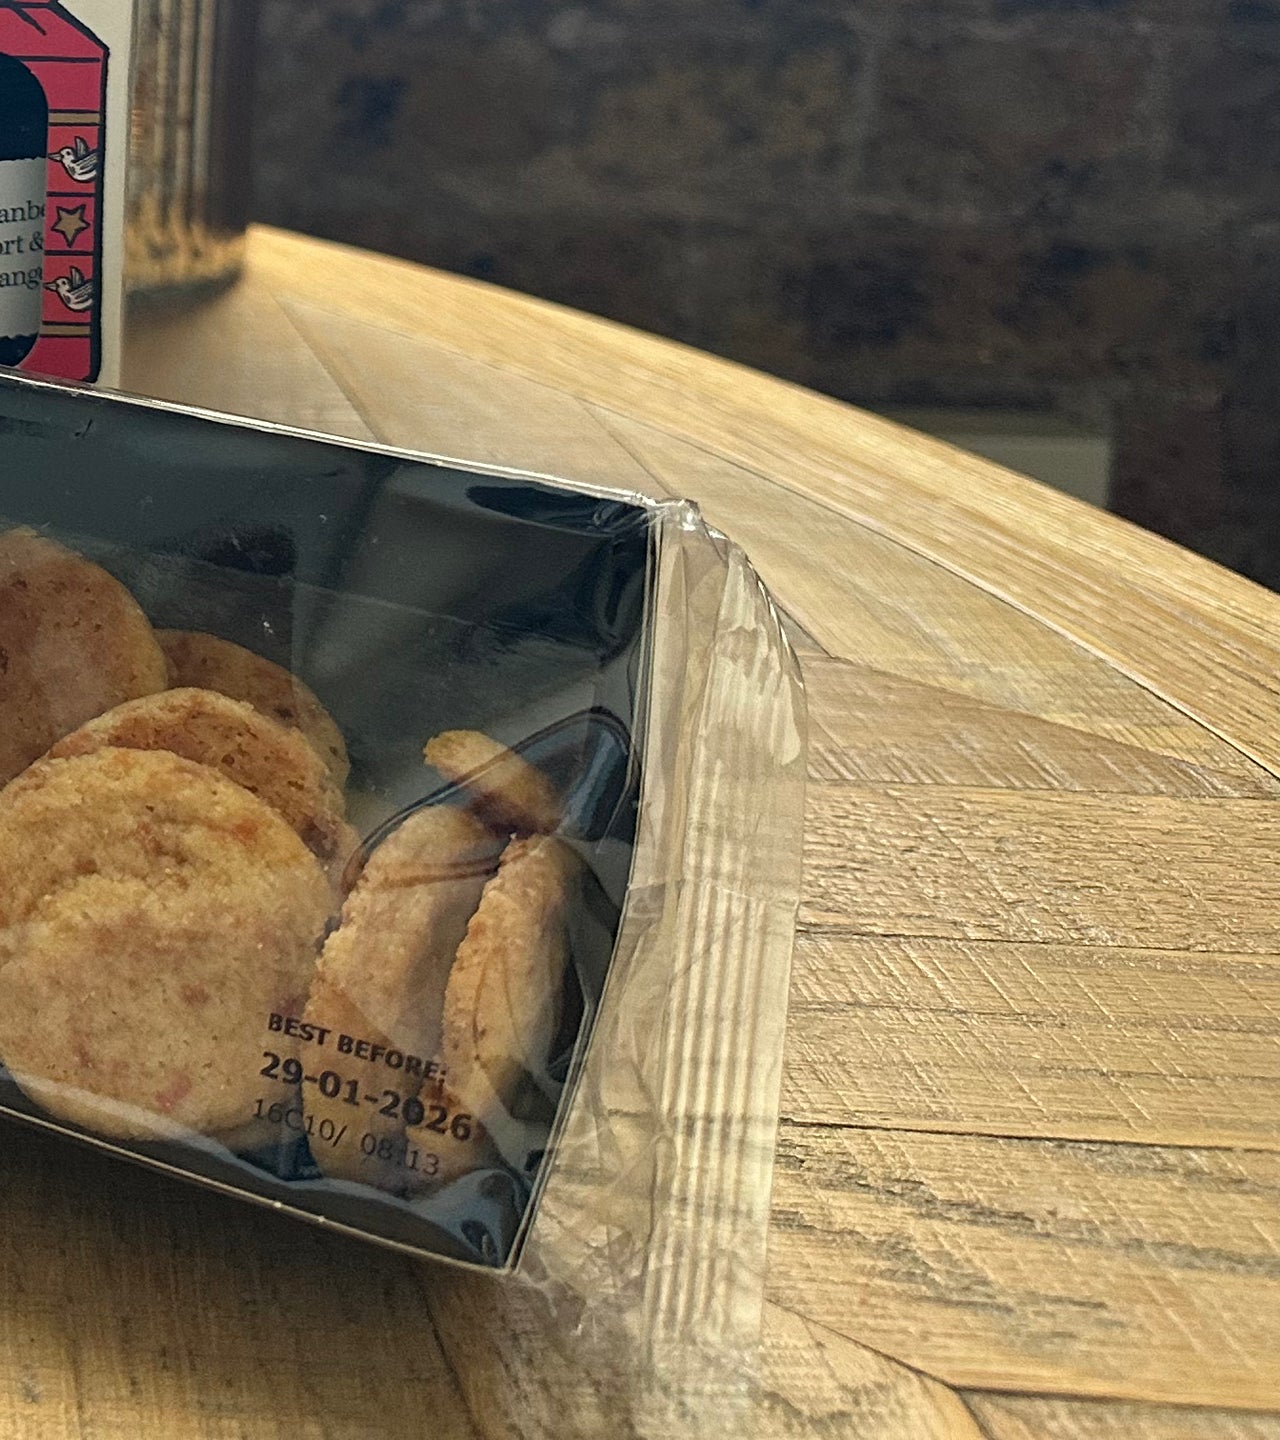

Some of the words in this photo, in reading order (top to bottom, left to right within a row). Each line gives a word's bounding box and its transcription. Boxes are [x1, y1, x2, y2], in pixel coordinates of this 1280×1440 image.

[28, 231, 44, 252] &
[267, 1012, 332, 1046] BEST
[260, 1050, 472, 1142] 29-01-2026
